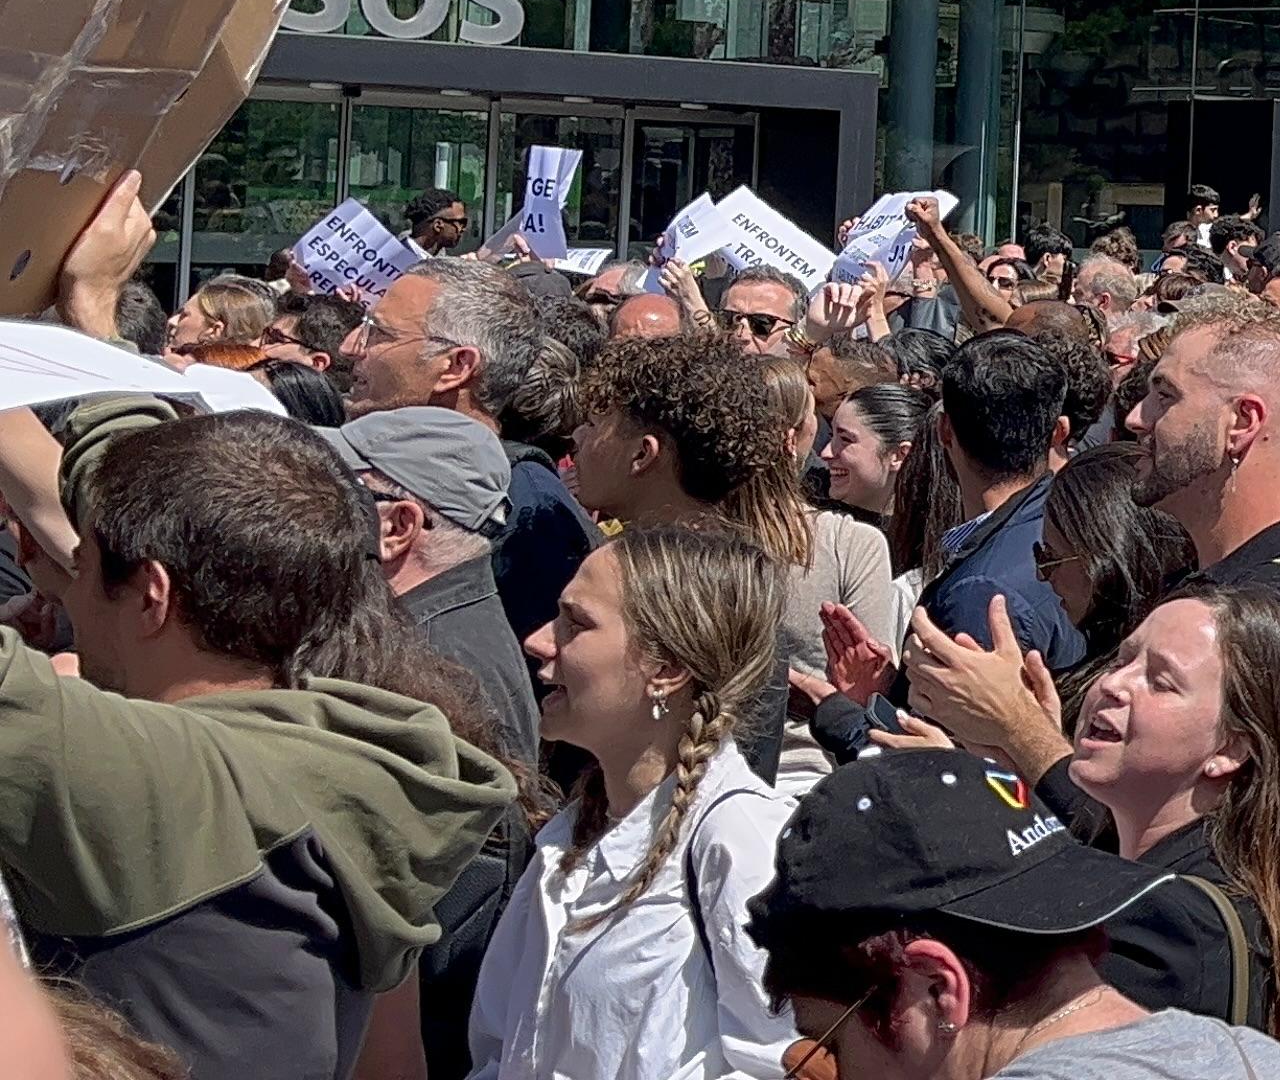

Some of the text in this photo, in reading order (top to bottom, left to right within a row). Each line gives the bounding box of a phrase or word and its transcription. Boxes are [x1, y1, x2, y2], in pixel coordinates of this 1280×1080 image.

[528, 176, 556, 197] GE
[853, 212, 910, 232] HABITA
[308, 235, 388, 299] ESPECULA
[326, 216, 404, 282] ENFRONT
[732, 213, 816, 279] ENFRONTEM
[734, 242, 764, 269] TRA
[1006, 813, 1066, 856] Ando
